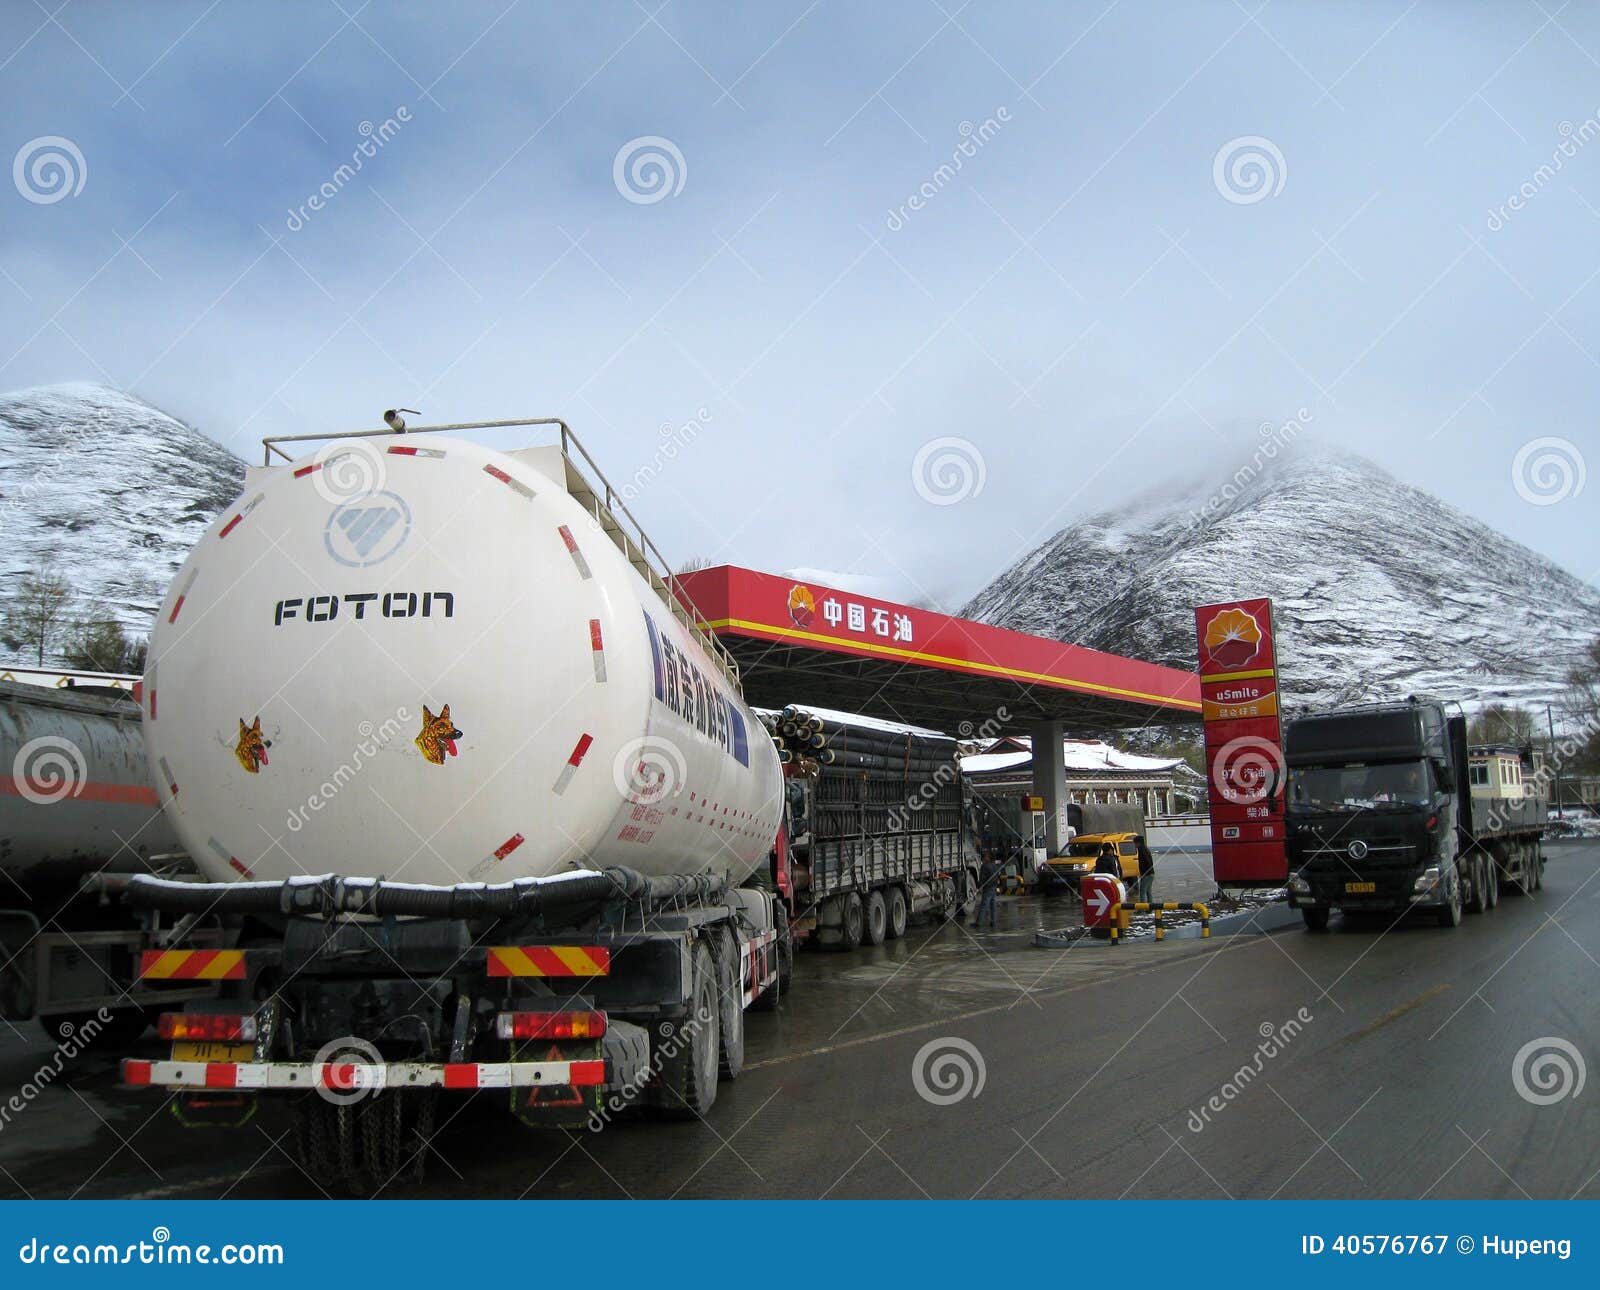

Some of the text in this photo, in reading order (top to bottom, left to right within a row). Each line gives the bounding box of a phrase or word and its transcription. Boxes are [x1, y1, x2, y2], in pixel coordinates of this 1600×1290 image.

[823, 598, 913, 642] 中国石油
[1216, 687, 1259, 700] uSmile
[1221, 767, 1266, 780] 97 汽油
[1223, 787, 1267, 799] 93 汽油
[1247, 807, 1269, 818] 柴油
